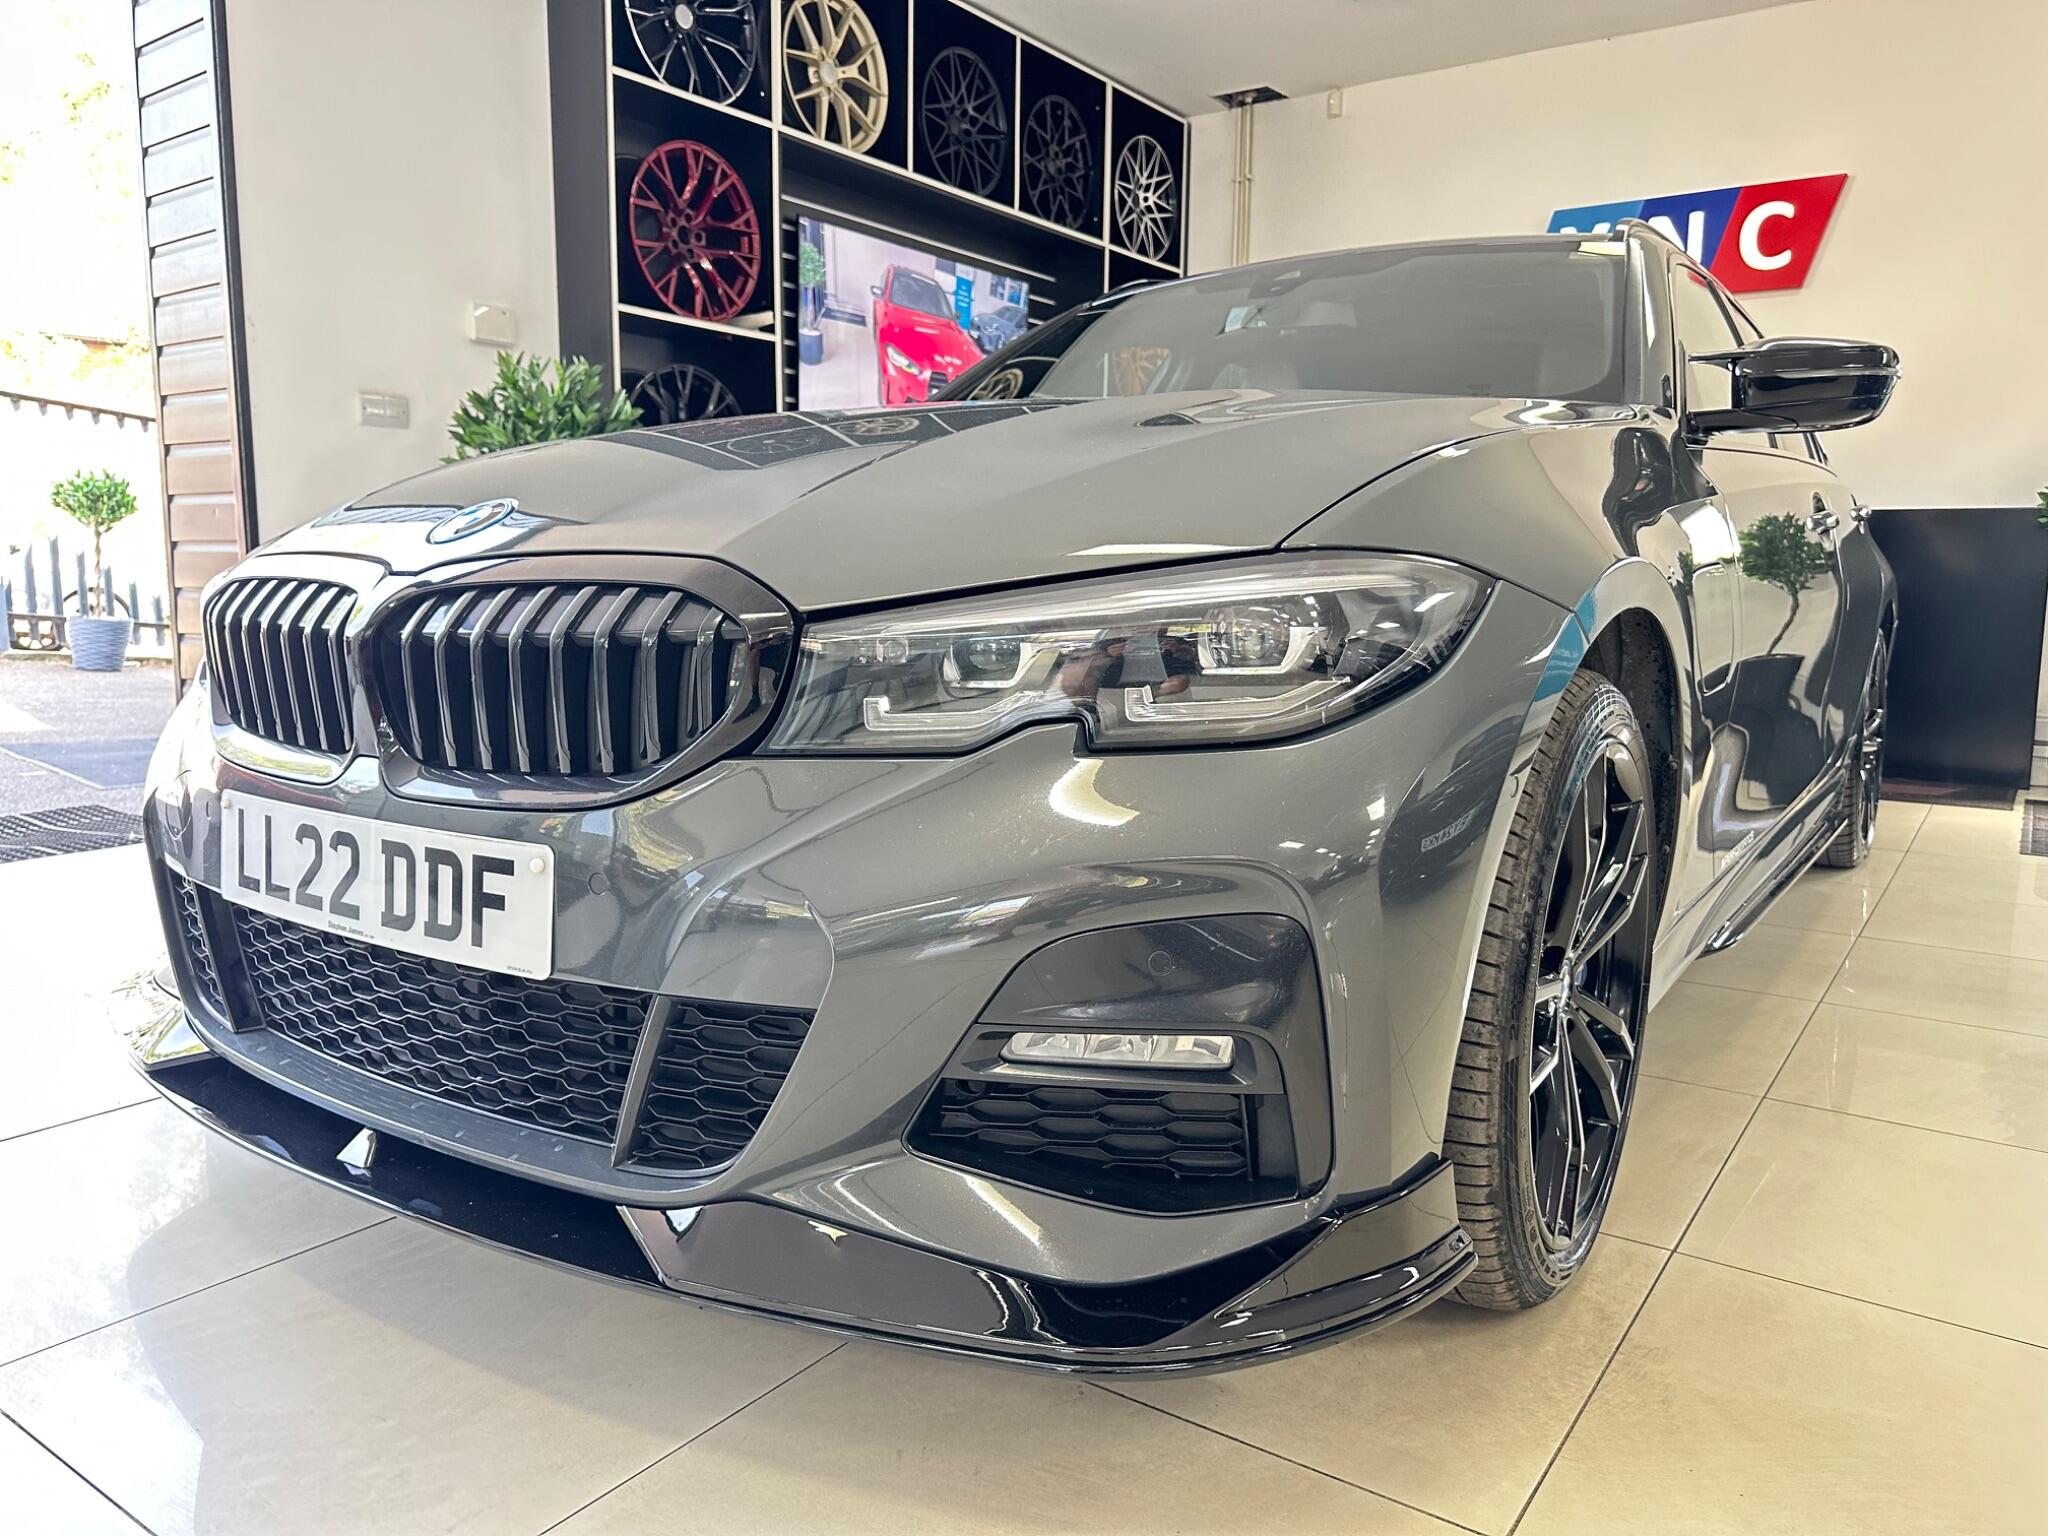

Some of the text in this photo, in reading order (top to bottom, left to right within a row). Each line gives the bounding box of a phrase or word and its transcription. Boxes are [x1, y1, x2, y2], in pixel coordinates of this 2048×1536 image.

[1560, 200, 1796, 271] NC
[238, 808, 515, 949] LL22 DDF
